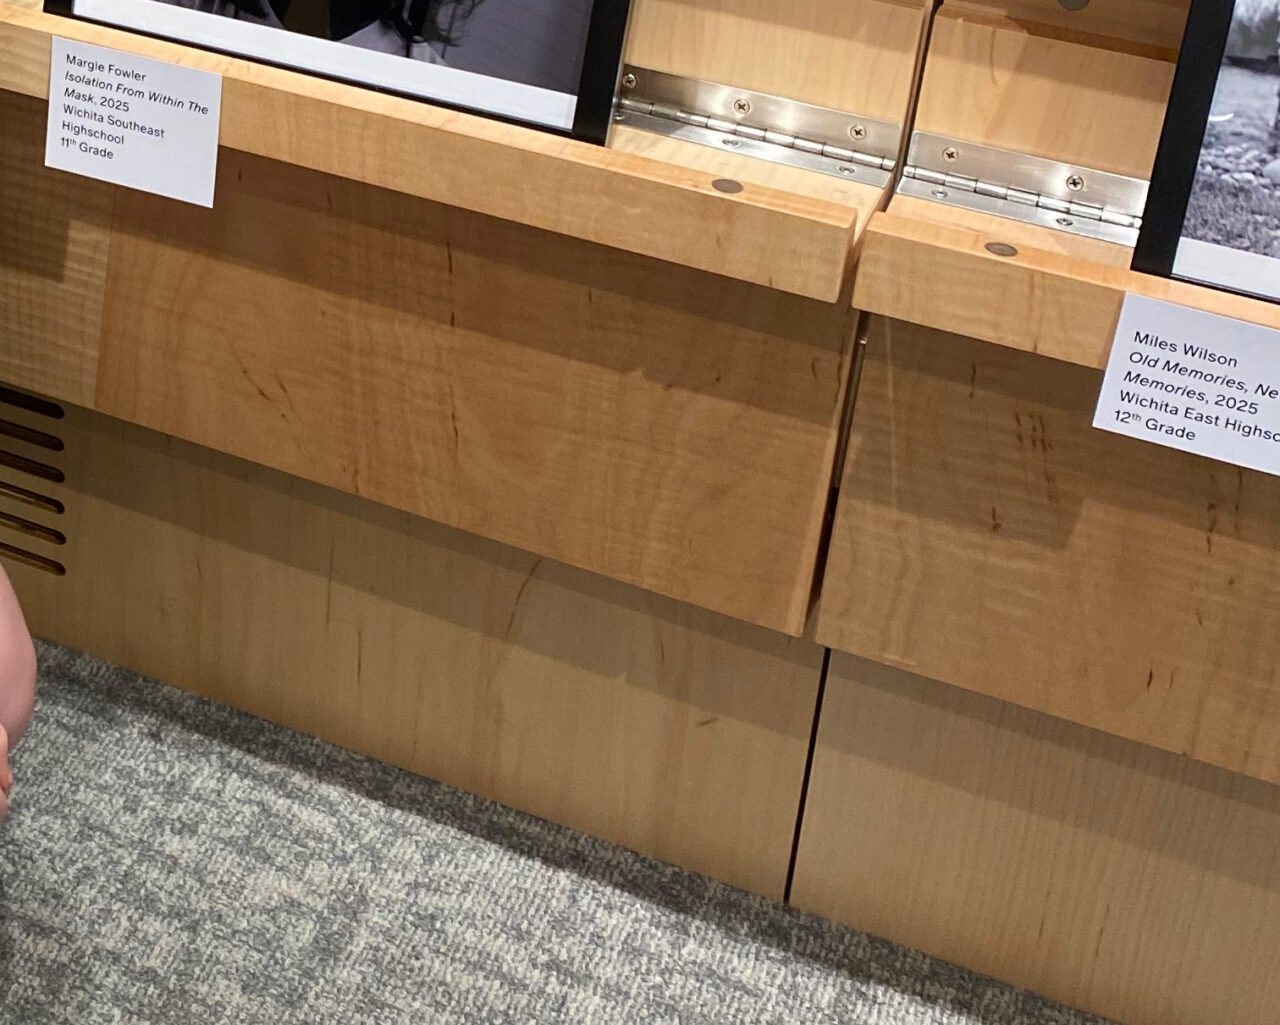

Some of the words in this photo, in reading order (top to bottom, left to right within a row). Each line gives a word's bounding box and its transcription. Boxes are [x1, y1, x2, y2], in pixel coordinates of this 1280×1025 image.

[66, 53, 105, 72] Margie
[108, 64, 147, 82] Fowler
[63, 87, 97, 106] Mask,
[100, 96, 130, 112] 2025
[64, 71, 113, 91] Isolation
[115, 83, 145, 99] From
[148, 91, 185, 109] Within
[188, 101, 209, 115] The
[61, 120, 125, 145] Highschool
[63, 103, 104, 123] Wichita
[106, 114, 165, 138] Southeast
[60, 137, 77, 148] 11th
[79, 142, 114, 159] Grade
[1133, 330, 1178, 353] Miles
[1183, 342, 1238, 368] Wilson
[1129, 351, 1160, 368] Old
[1162, 359, 1249, 394] Memories,
[1119, 389, 1179, 416] Wichita
[1184, 407, 1221, 427] East
[1123, 370, 1209, 404] Memories,
[1214, 394, 1260, 415] 2025
[1114, 409, 1142, 424] 12th
[1145, 417, 1196, 441] Grade
